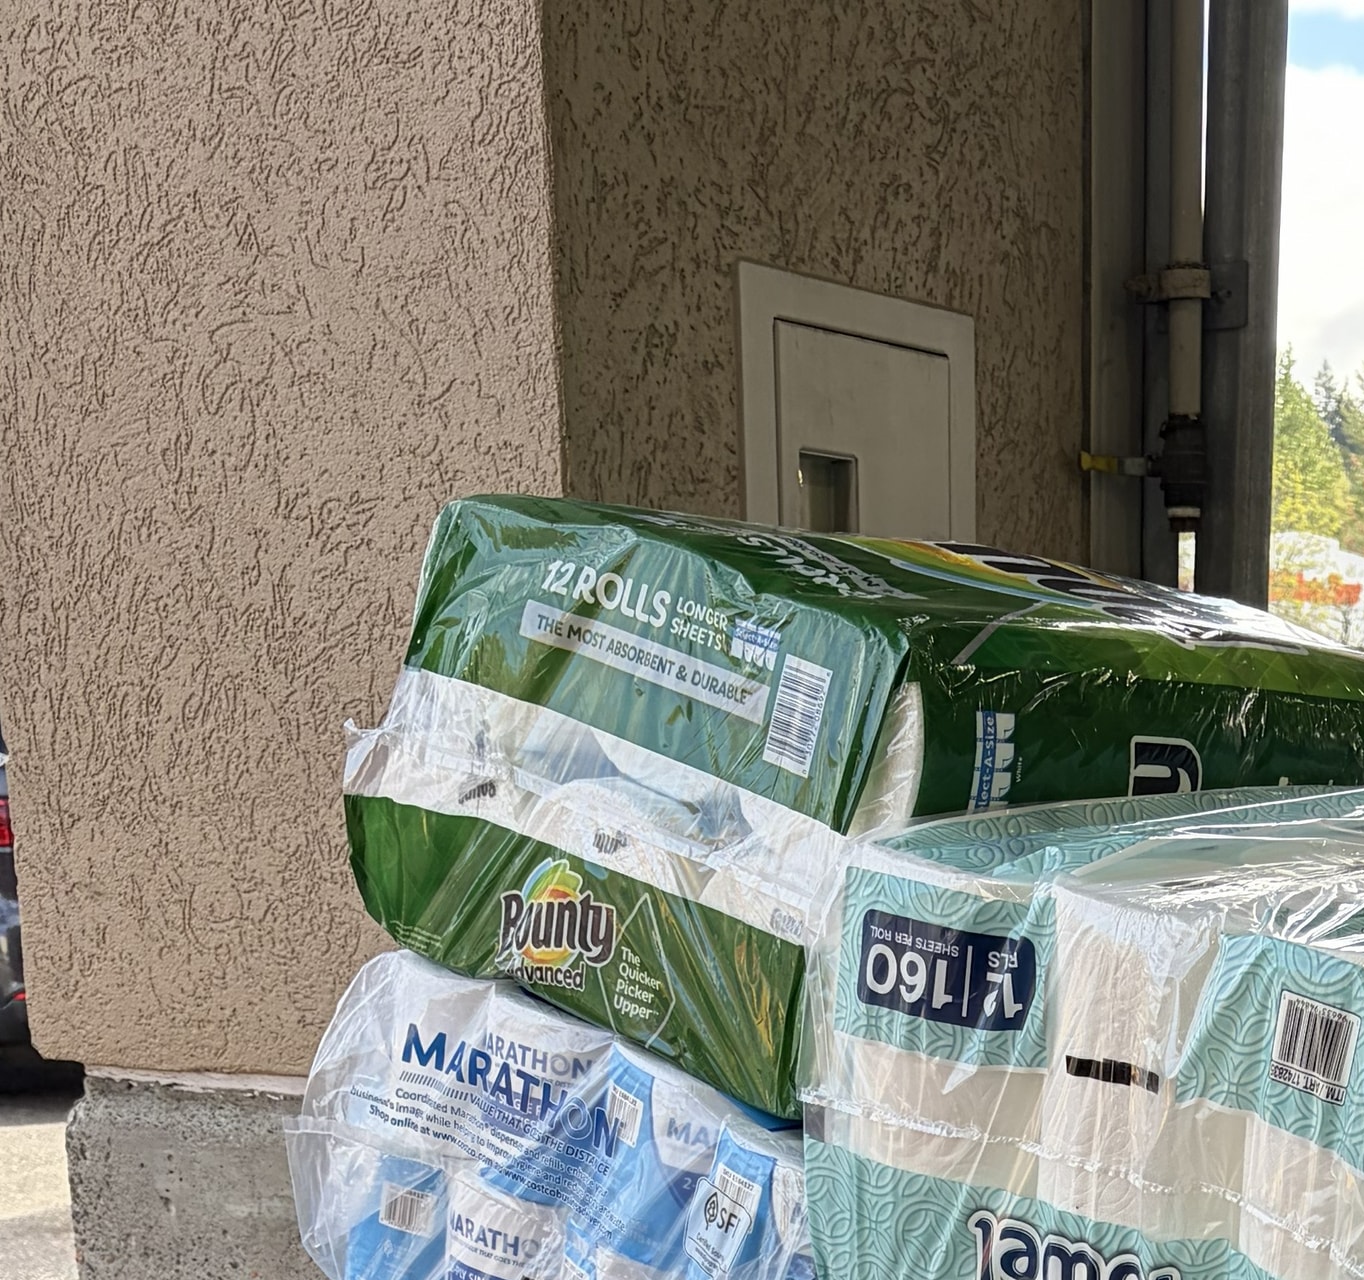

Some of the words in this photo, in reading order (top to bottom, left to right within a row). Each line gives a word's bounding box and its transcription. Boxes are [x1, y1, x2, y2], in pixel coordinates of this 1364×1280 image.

[542, 560, 576, 595] 12
[573, 566, 671, 628] ROLLS
[677, 597, 729, 631] LONGER
[537, 614, 563, 638] THE
[566, 623, 606, 650] MOST
[606, 637, 675, 676] ABSORBENT
[676, 665, 687, 682] &
[501, 889, 616, 966] Bounty
[870, 925, 892, 942] ROLL
[895, 931, 912, 947] PER
[621, 946, 641, 968] The
[916, 937, 959, 957] SHEETS
[988, 951, 1018, 969] RLS
[616, 978, 655, 1005] Picker
[618, 960, 663, 992] Quicker
[866, 943, 953, 1010] 160
[401, 1023, 625, 1158] MARATHON
[368, 1104, 389, 1124] Shop
[389, 1116, 419, 1132] online
[419, 1125, 431, 1136] at
[469, 1092, 495, 1118] VALUE
[495, 1110, 522, 1130] THAT
[544, 1132, 564, 1152] THE
[564, 1142, 610, 1177] DISTANCE
[425, 1110, 452, 1130] while
[476, 1134, 486, 1146] to
[542, 1171, 561, 1187] and
[523, 1145, 541, 1161] and
[716, 1205, 742, 1239] SFI
